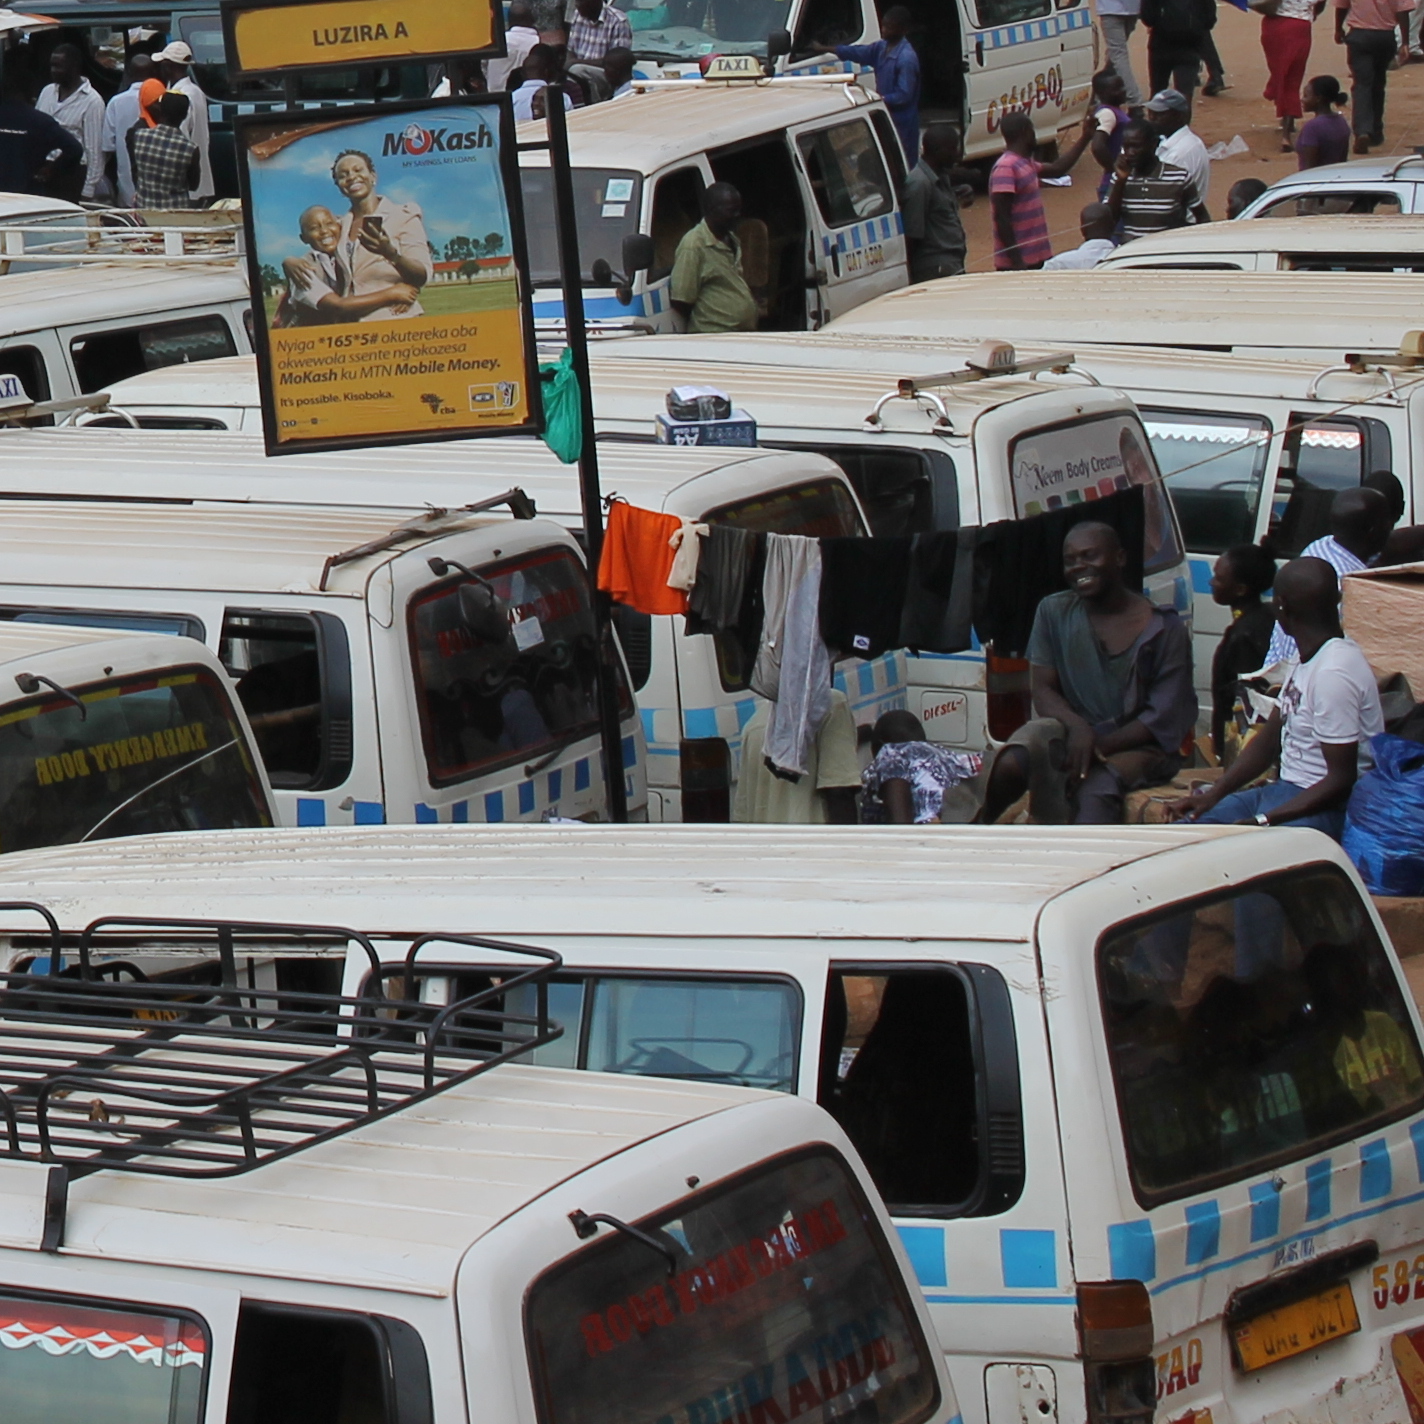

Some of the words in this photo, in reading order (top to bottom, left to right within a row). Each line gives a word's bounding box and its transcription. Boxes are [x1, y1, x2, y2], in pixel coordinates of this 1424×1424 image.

[312, 23, 389, 46] LUZIRA
[394, 21, 409, 38] A
[716, 58, 749, 71] TAXI
[381, 124, 493, 158] MoKash
[454, 155, 477, 164] LOANS
[277, 339, 315, 356] Nyiga
[380, 328, 449, 345] okutereka
[450, 324, 478, 338] oba
[277, 352, 346, 371] okwewola
[348, 348, 391, 363] ssente
[279, 368, 338, 386] MoKash
[340, 367, 357, 381] ku
[358, 365, 393, 380] MTN
[394, 360, 445, 377] Mobile
[446, 357, 501, 376] Money.
[280, 397, 294, 408] It's
[296, 394, 341, 408] possible.
[342, 390, 395, 402] Kisoboka.
[439, 405, 456, 415] cba
[1066, 457, 1090, 479] Body
[1090, 455, 1123, 474] Creams
[923, 702, 957, 721] DIESEL
